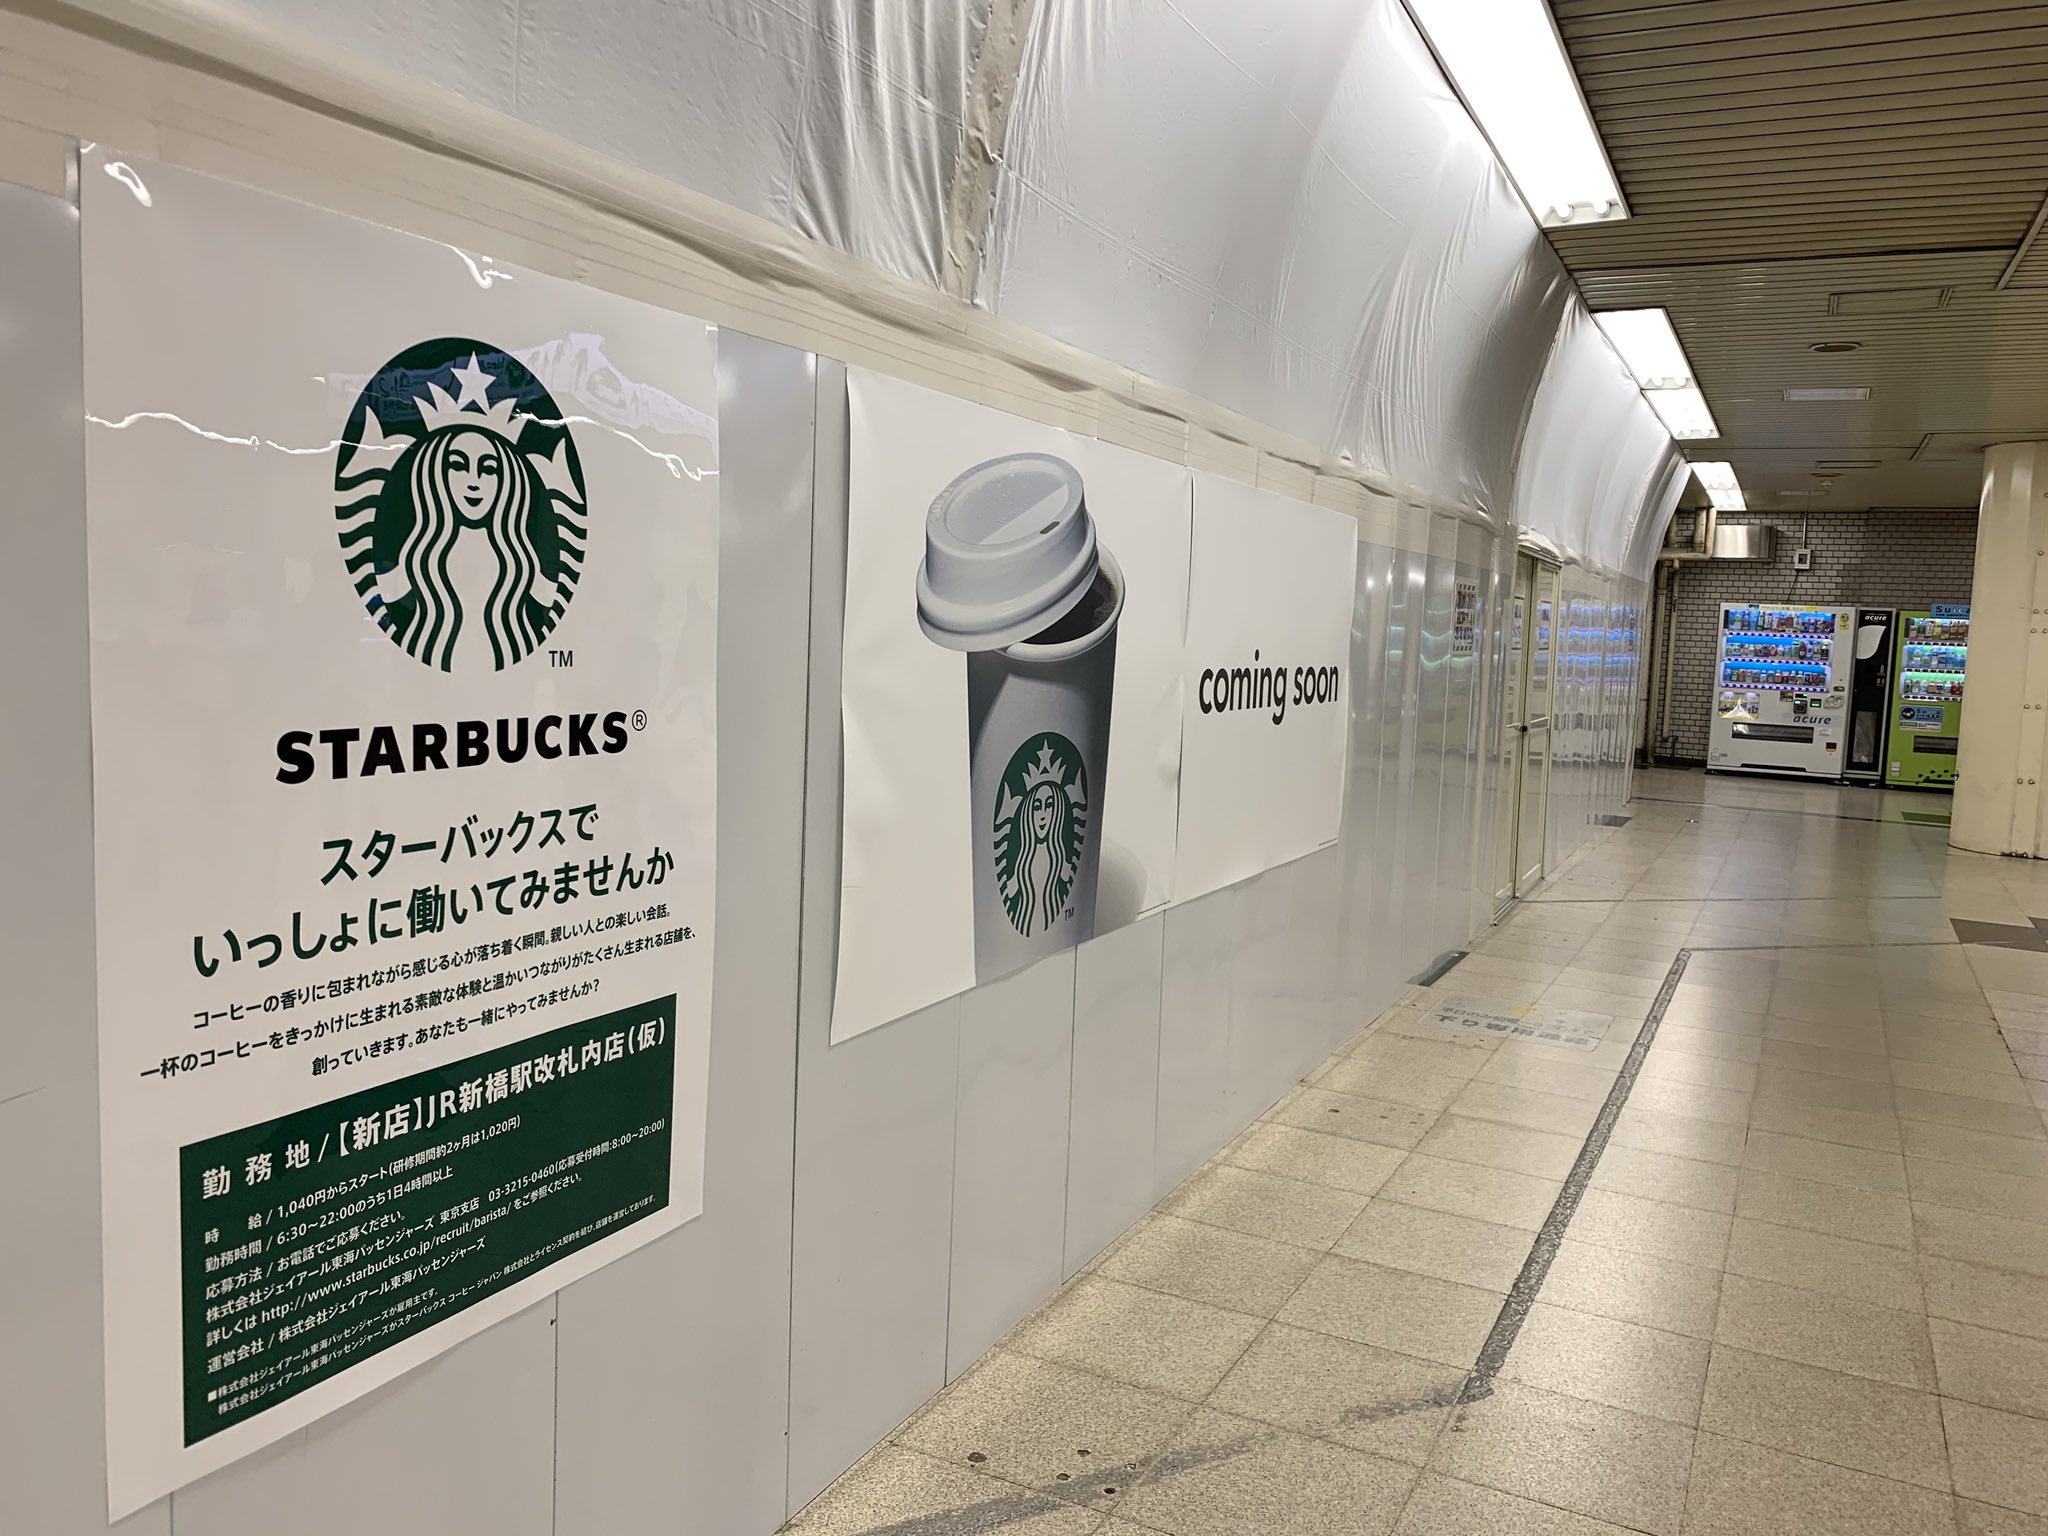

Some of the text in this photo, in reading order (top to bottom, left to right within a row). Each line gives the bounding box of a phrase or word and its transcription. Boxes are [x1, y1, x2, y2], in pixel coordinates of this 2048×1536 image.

[548, 650, 574, 668] TM
[1199, 649, 1339, 725] coming soon
[1793, 715, 1832, 725] acure
[320, 803, 598, 886] スターバックスで
[193, 846, 675, 978] いっしょに働いてみませんか
[1063, 906, 1075, 920] TM
